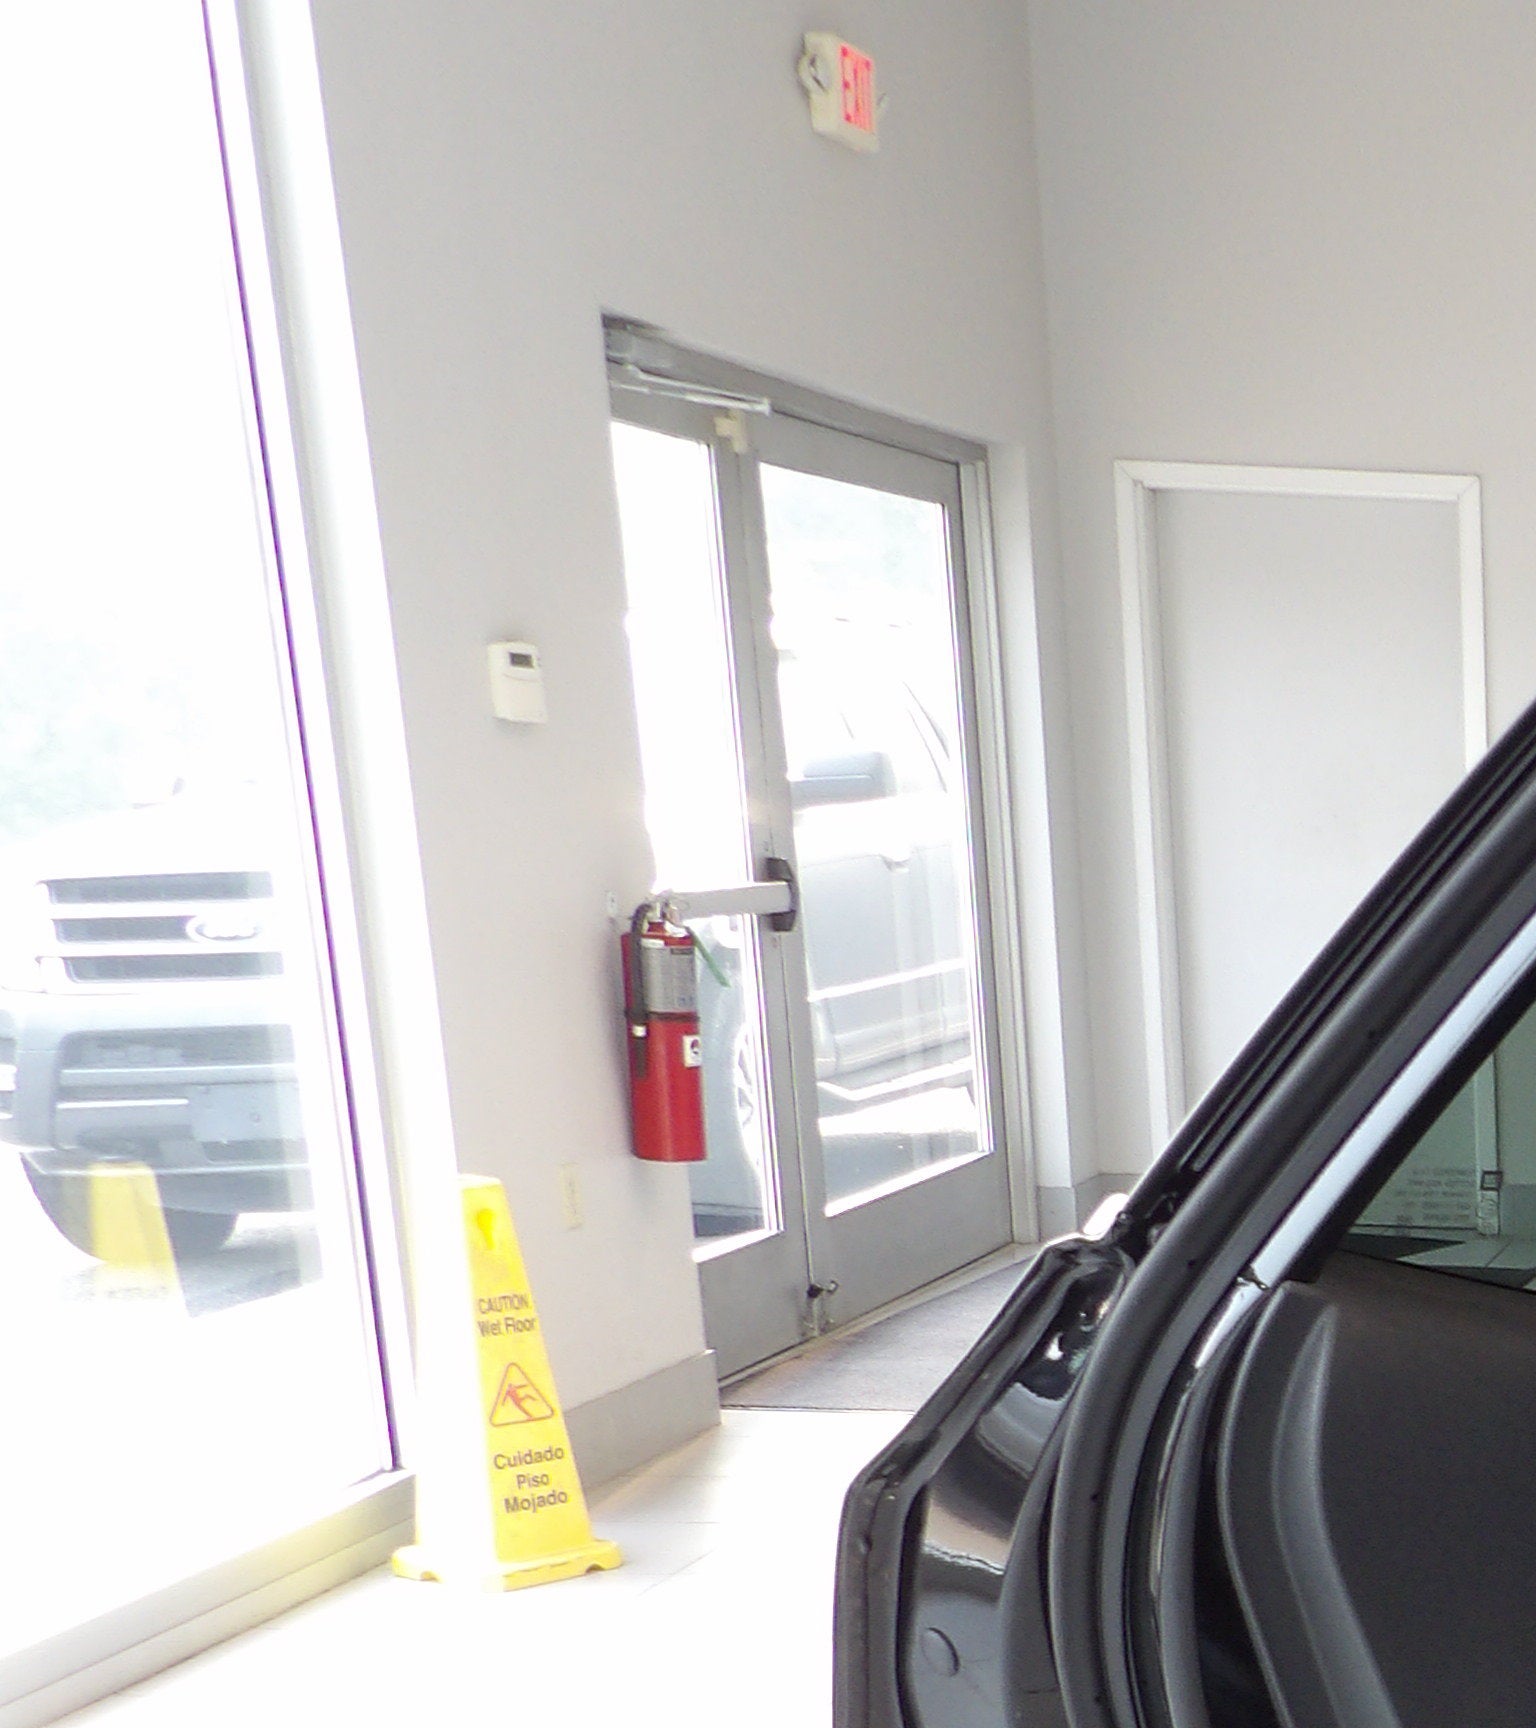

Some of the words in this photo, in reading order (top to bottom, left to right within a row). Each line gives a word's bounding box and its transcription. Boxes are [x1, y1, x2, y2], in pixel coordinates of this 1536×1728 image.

[840, 45, 873, 133] EXIT
[478, 1293, 529, 1314] CAUTION
[477, 1319, 503, 1337] Wet
[504, 1316, 536, 1334] Floor
[493, 1446, 564, 1470] Cuidado
[516, 1473, 550, 1490] Piso
[504, 1489, 568, 1514] Mojado
